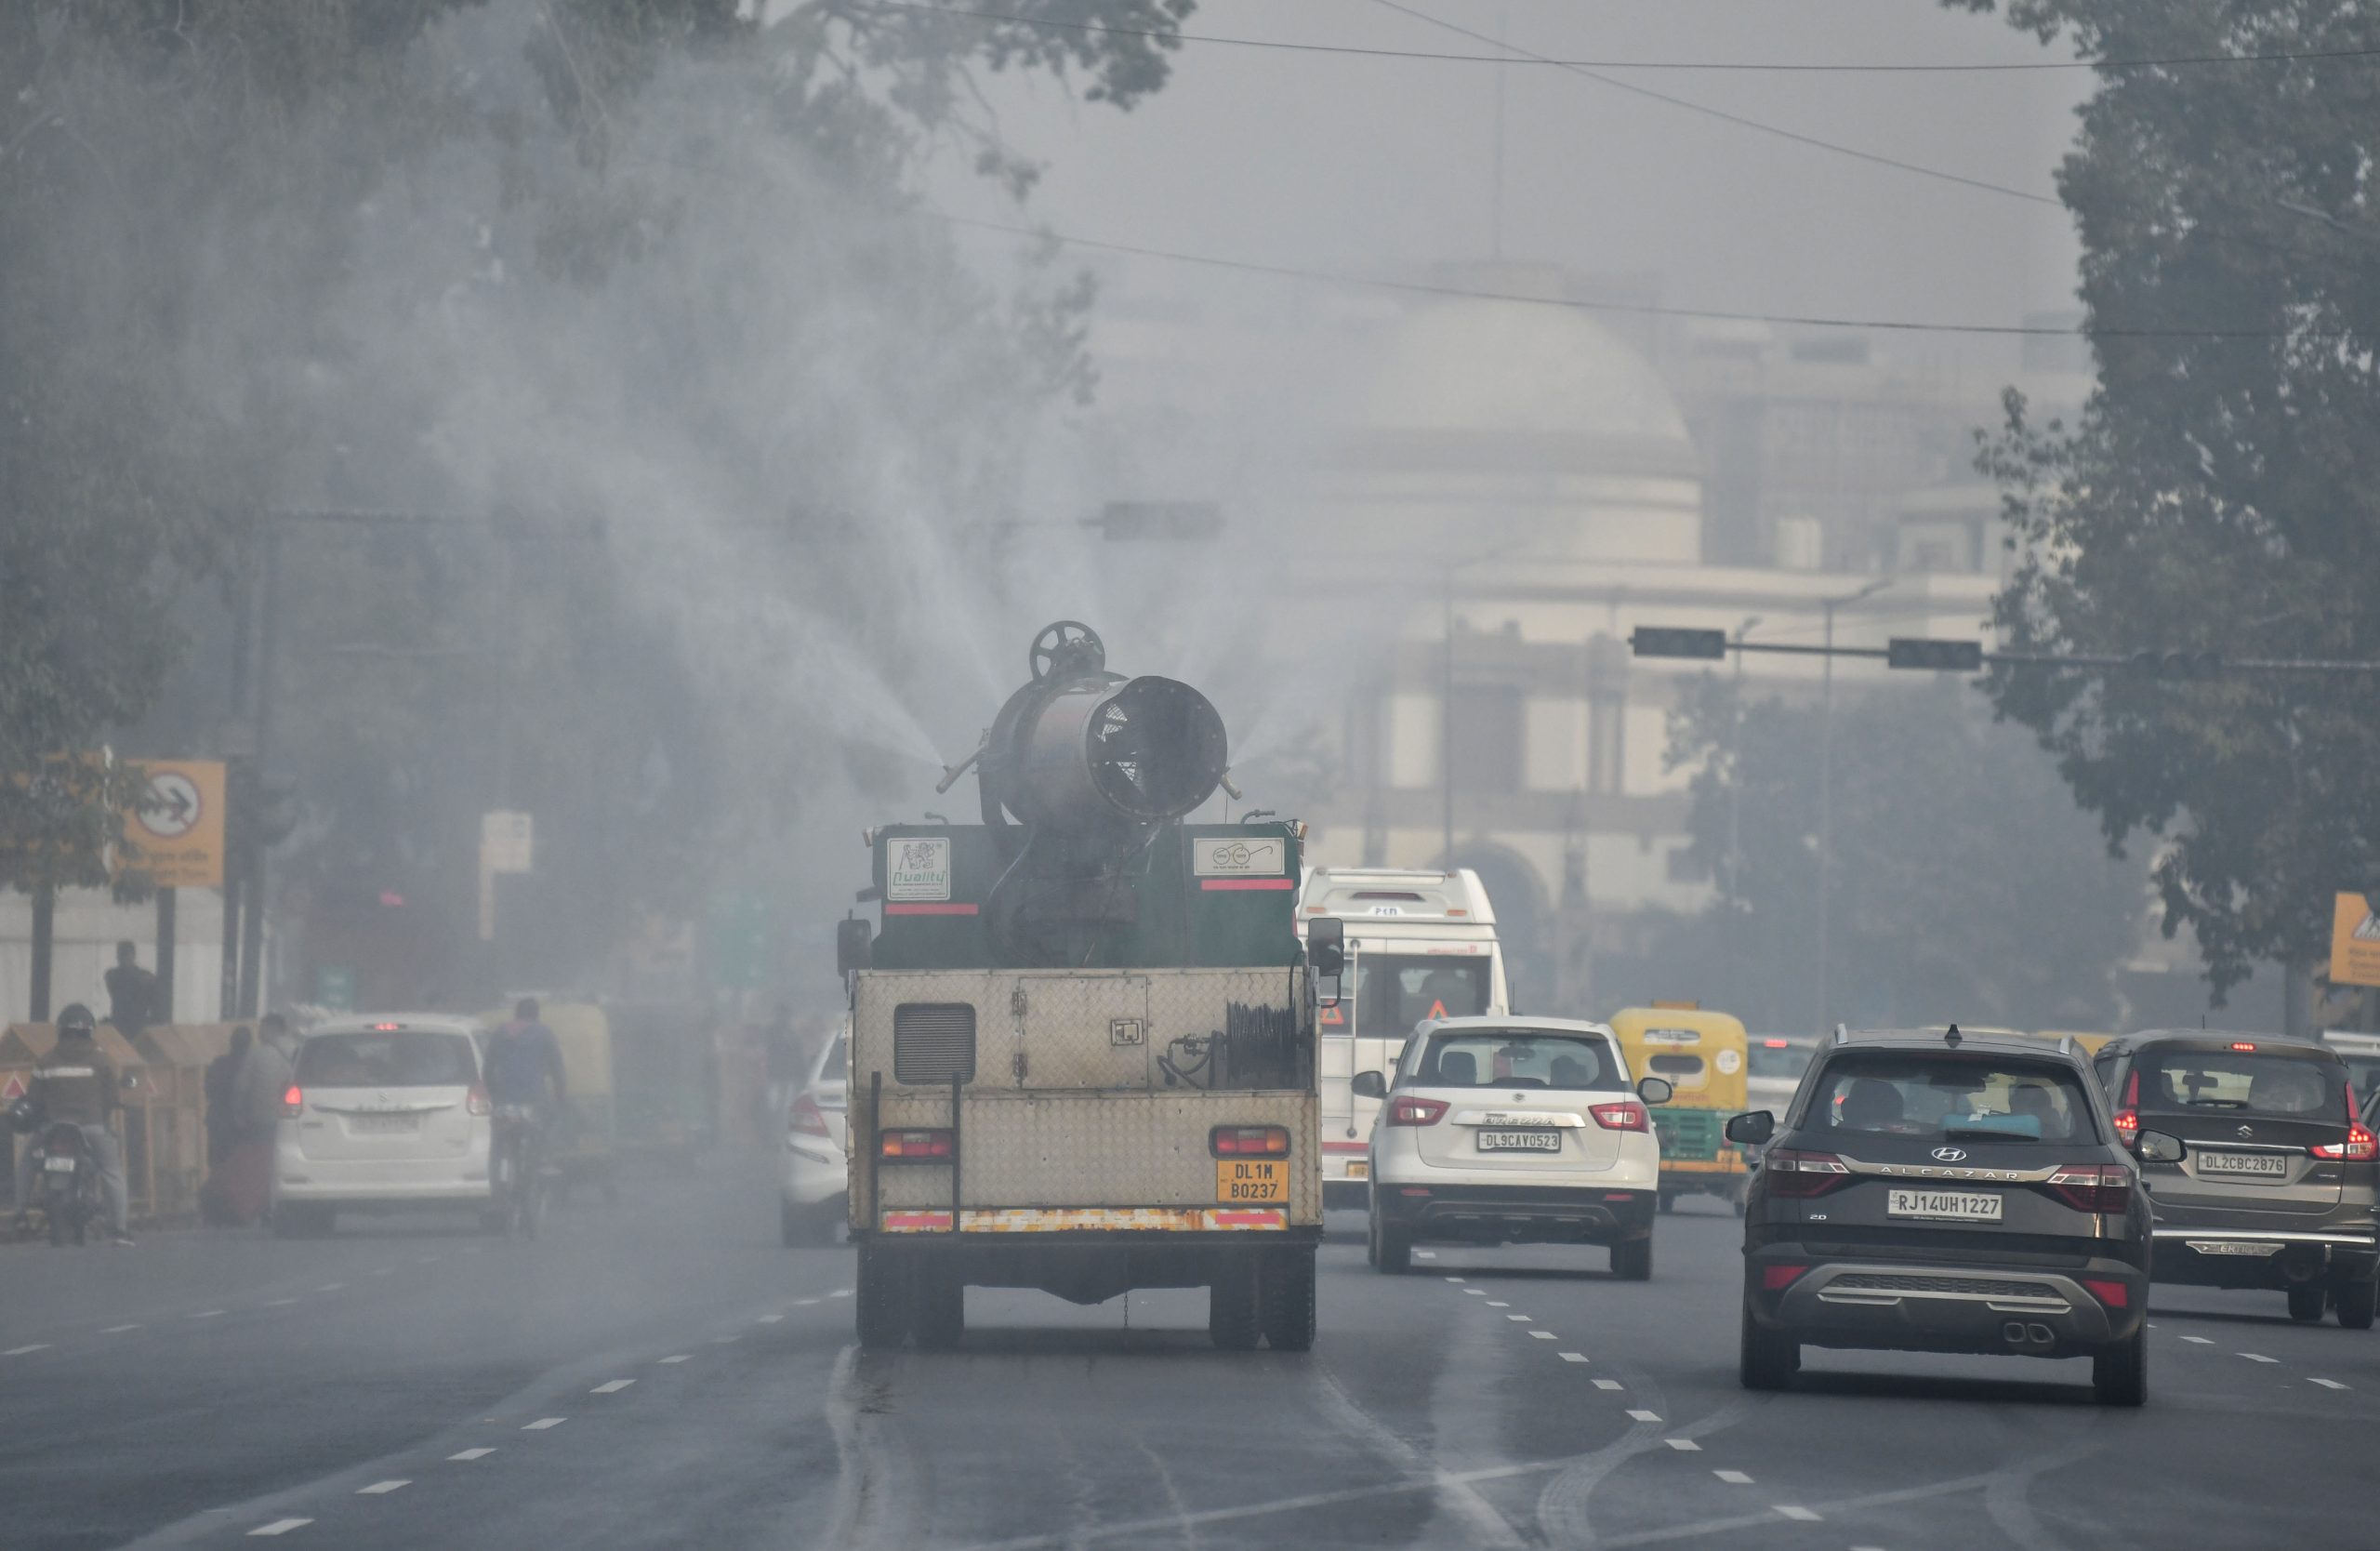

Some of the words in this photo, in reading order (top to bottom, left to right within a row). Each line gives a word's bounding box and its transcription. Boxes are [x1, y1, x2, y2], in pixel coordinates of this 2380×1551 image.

[1483, 1116, 1555, 1126] BREZZA
[1486, 1134, 1558, 1147] DL9CAV0523
[2205, 1156, 2283, 1172] DL2CBC2876
[1881, 1166, 2018, 1180] ALCAZAR
[1231, 1183, 1278, 1199] B0237
[1898, 1195, 2000, 1214] RJ14UH1227
